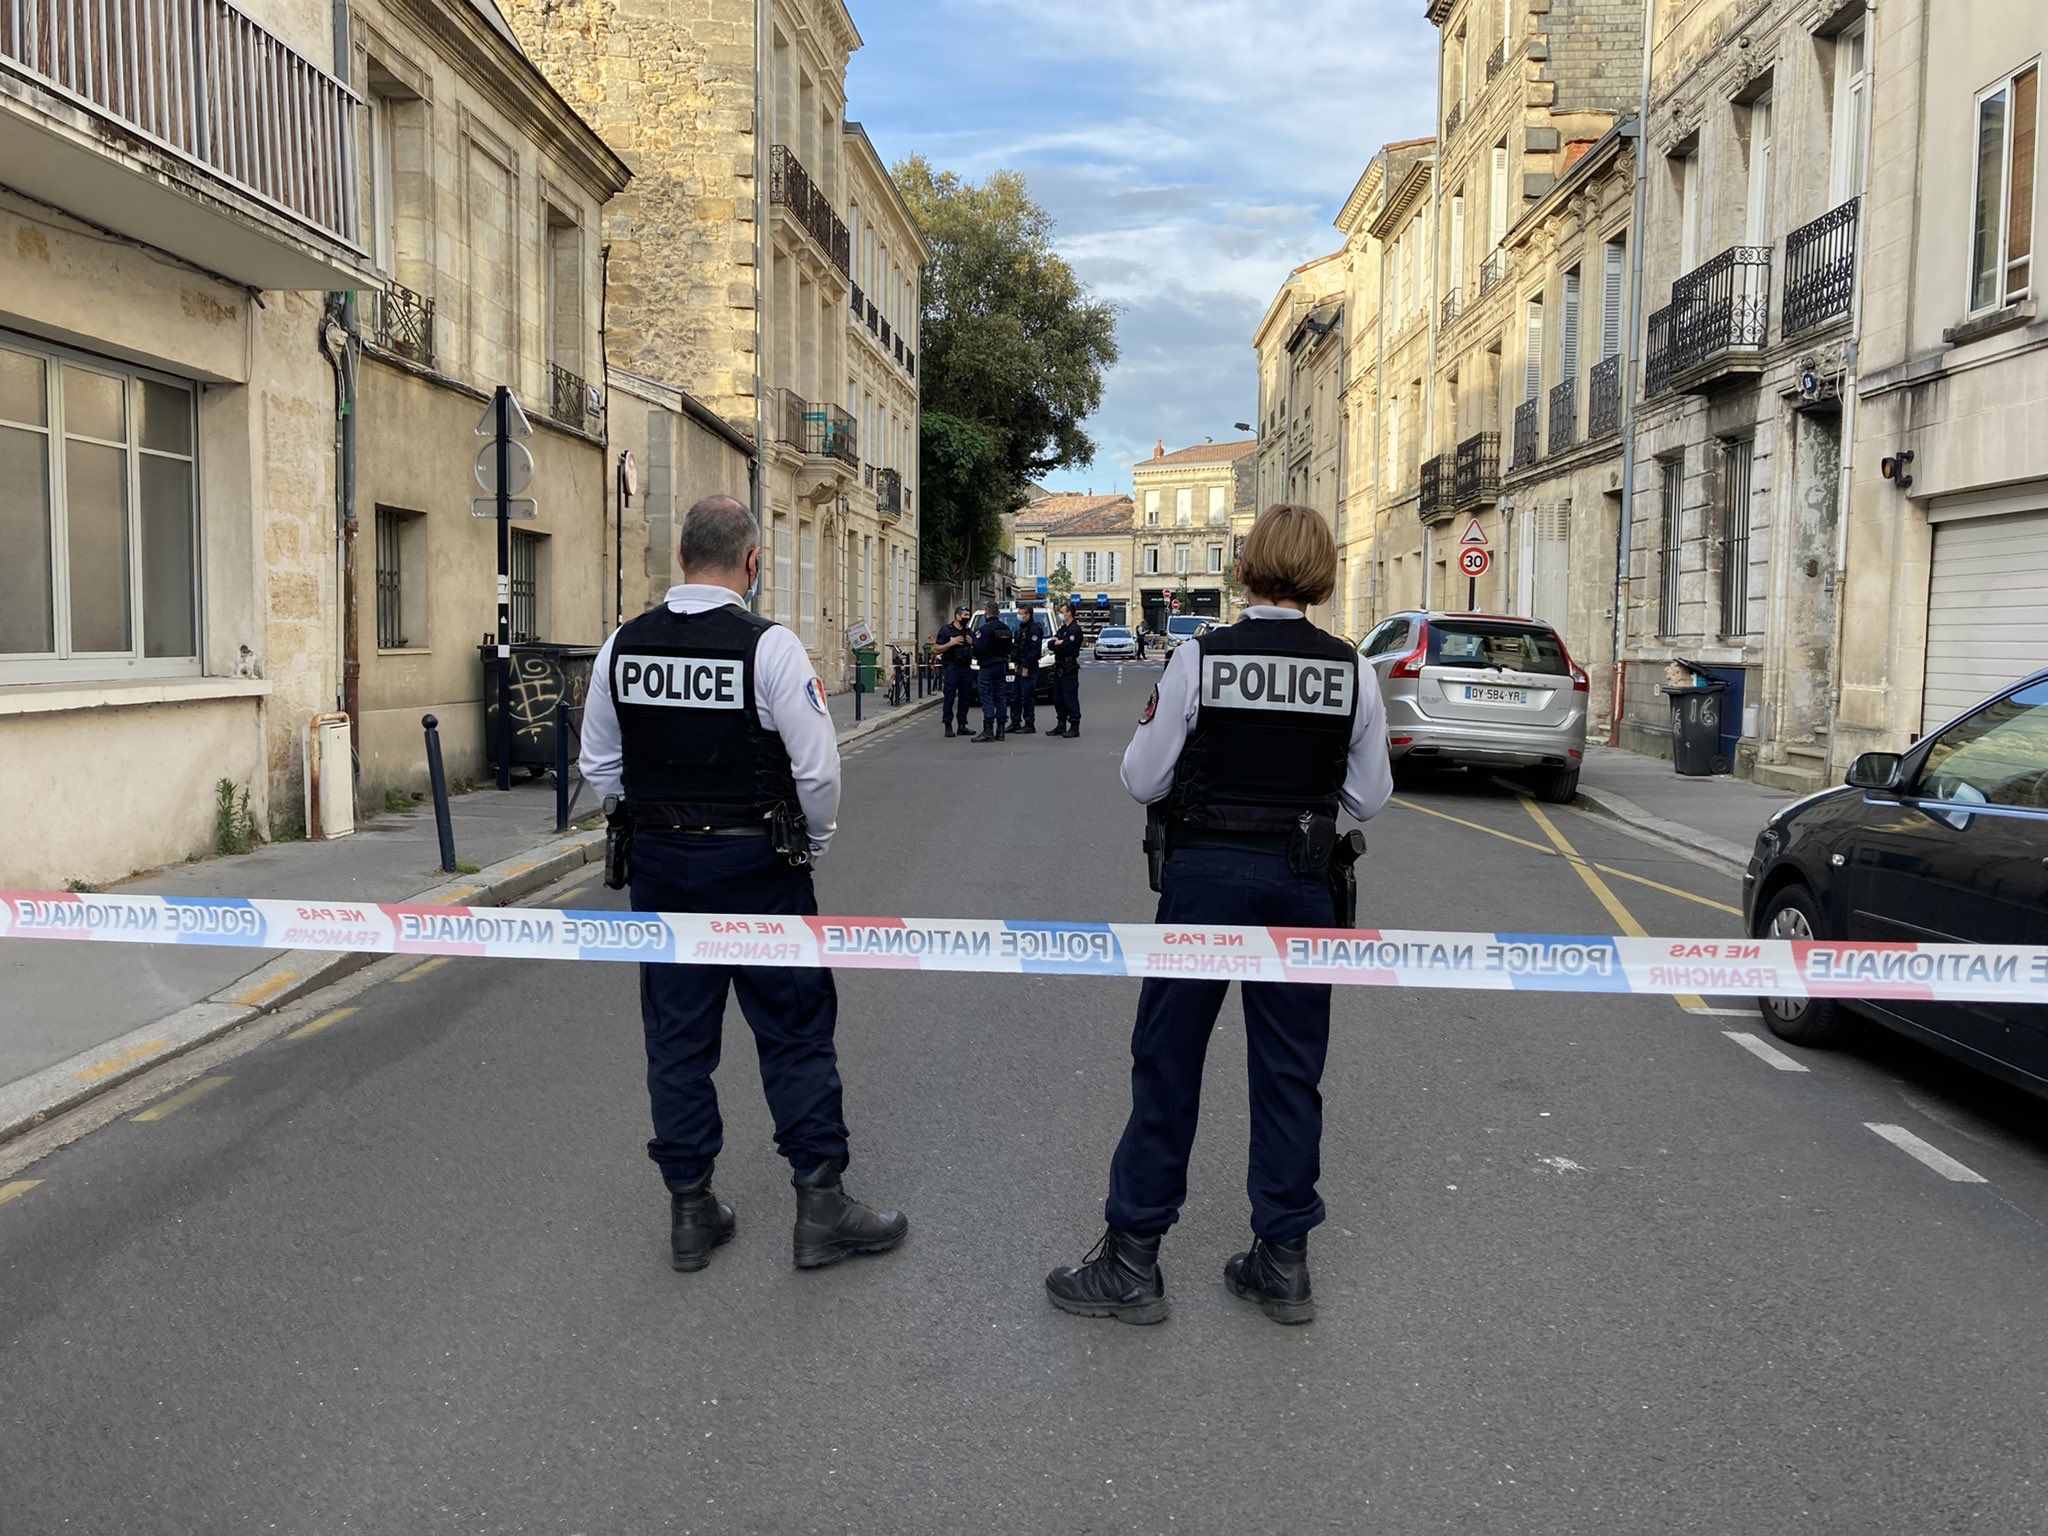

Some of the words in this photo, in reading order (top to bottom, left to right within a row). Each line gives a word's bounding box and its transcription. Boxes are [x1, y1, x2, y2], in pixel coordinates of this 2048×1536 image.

[1465, 555, 1483, 568] 30
[622, 661, 734, 702] POLICE
[1212, 662, 1344, 707] POLICE
[1690, 697, 1718, 726] 16
